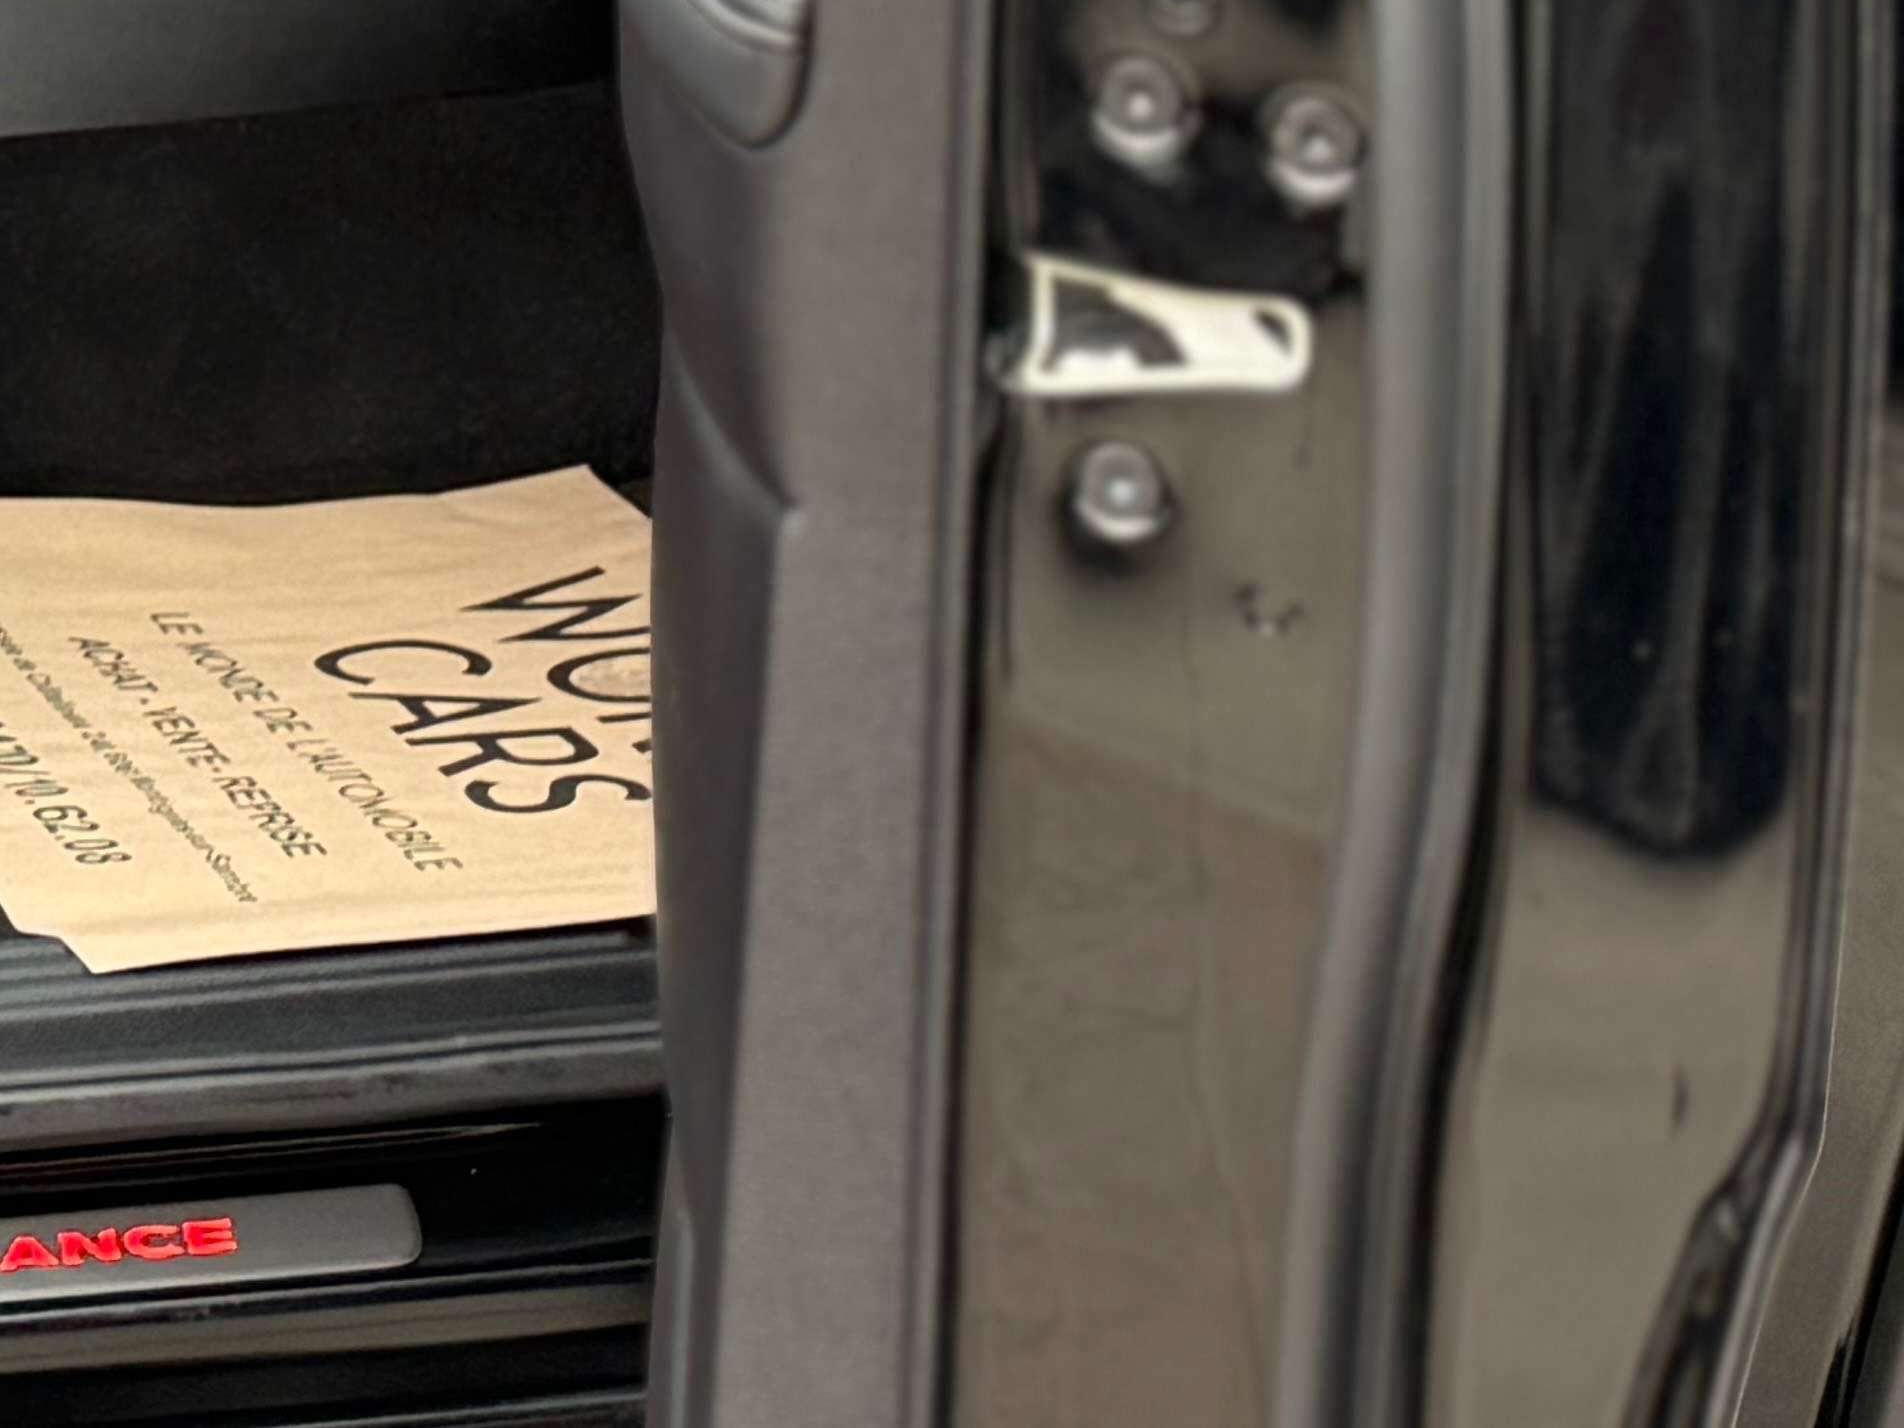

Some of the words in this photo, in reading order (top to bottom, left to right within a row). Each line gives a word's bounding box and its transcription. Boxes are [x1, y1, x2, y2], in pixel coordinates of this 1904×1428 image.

[149, 611, 205, 635] LE
[175, 641, 280, 703] MONDE
[67, 636, 160, 693] ACHAT
[211, 775, 328, 859] REPRISE
[252, 706, 313, 734] DE
[313, 639, 652, 814] CARS
